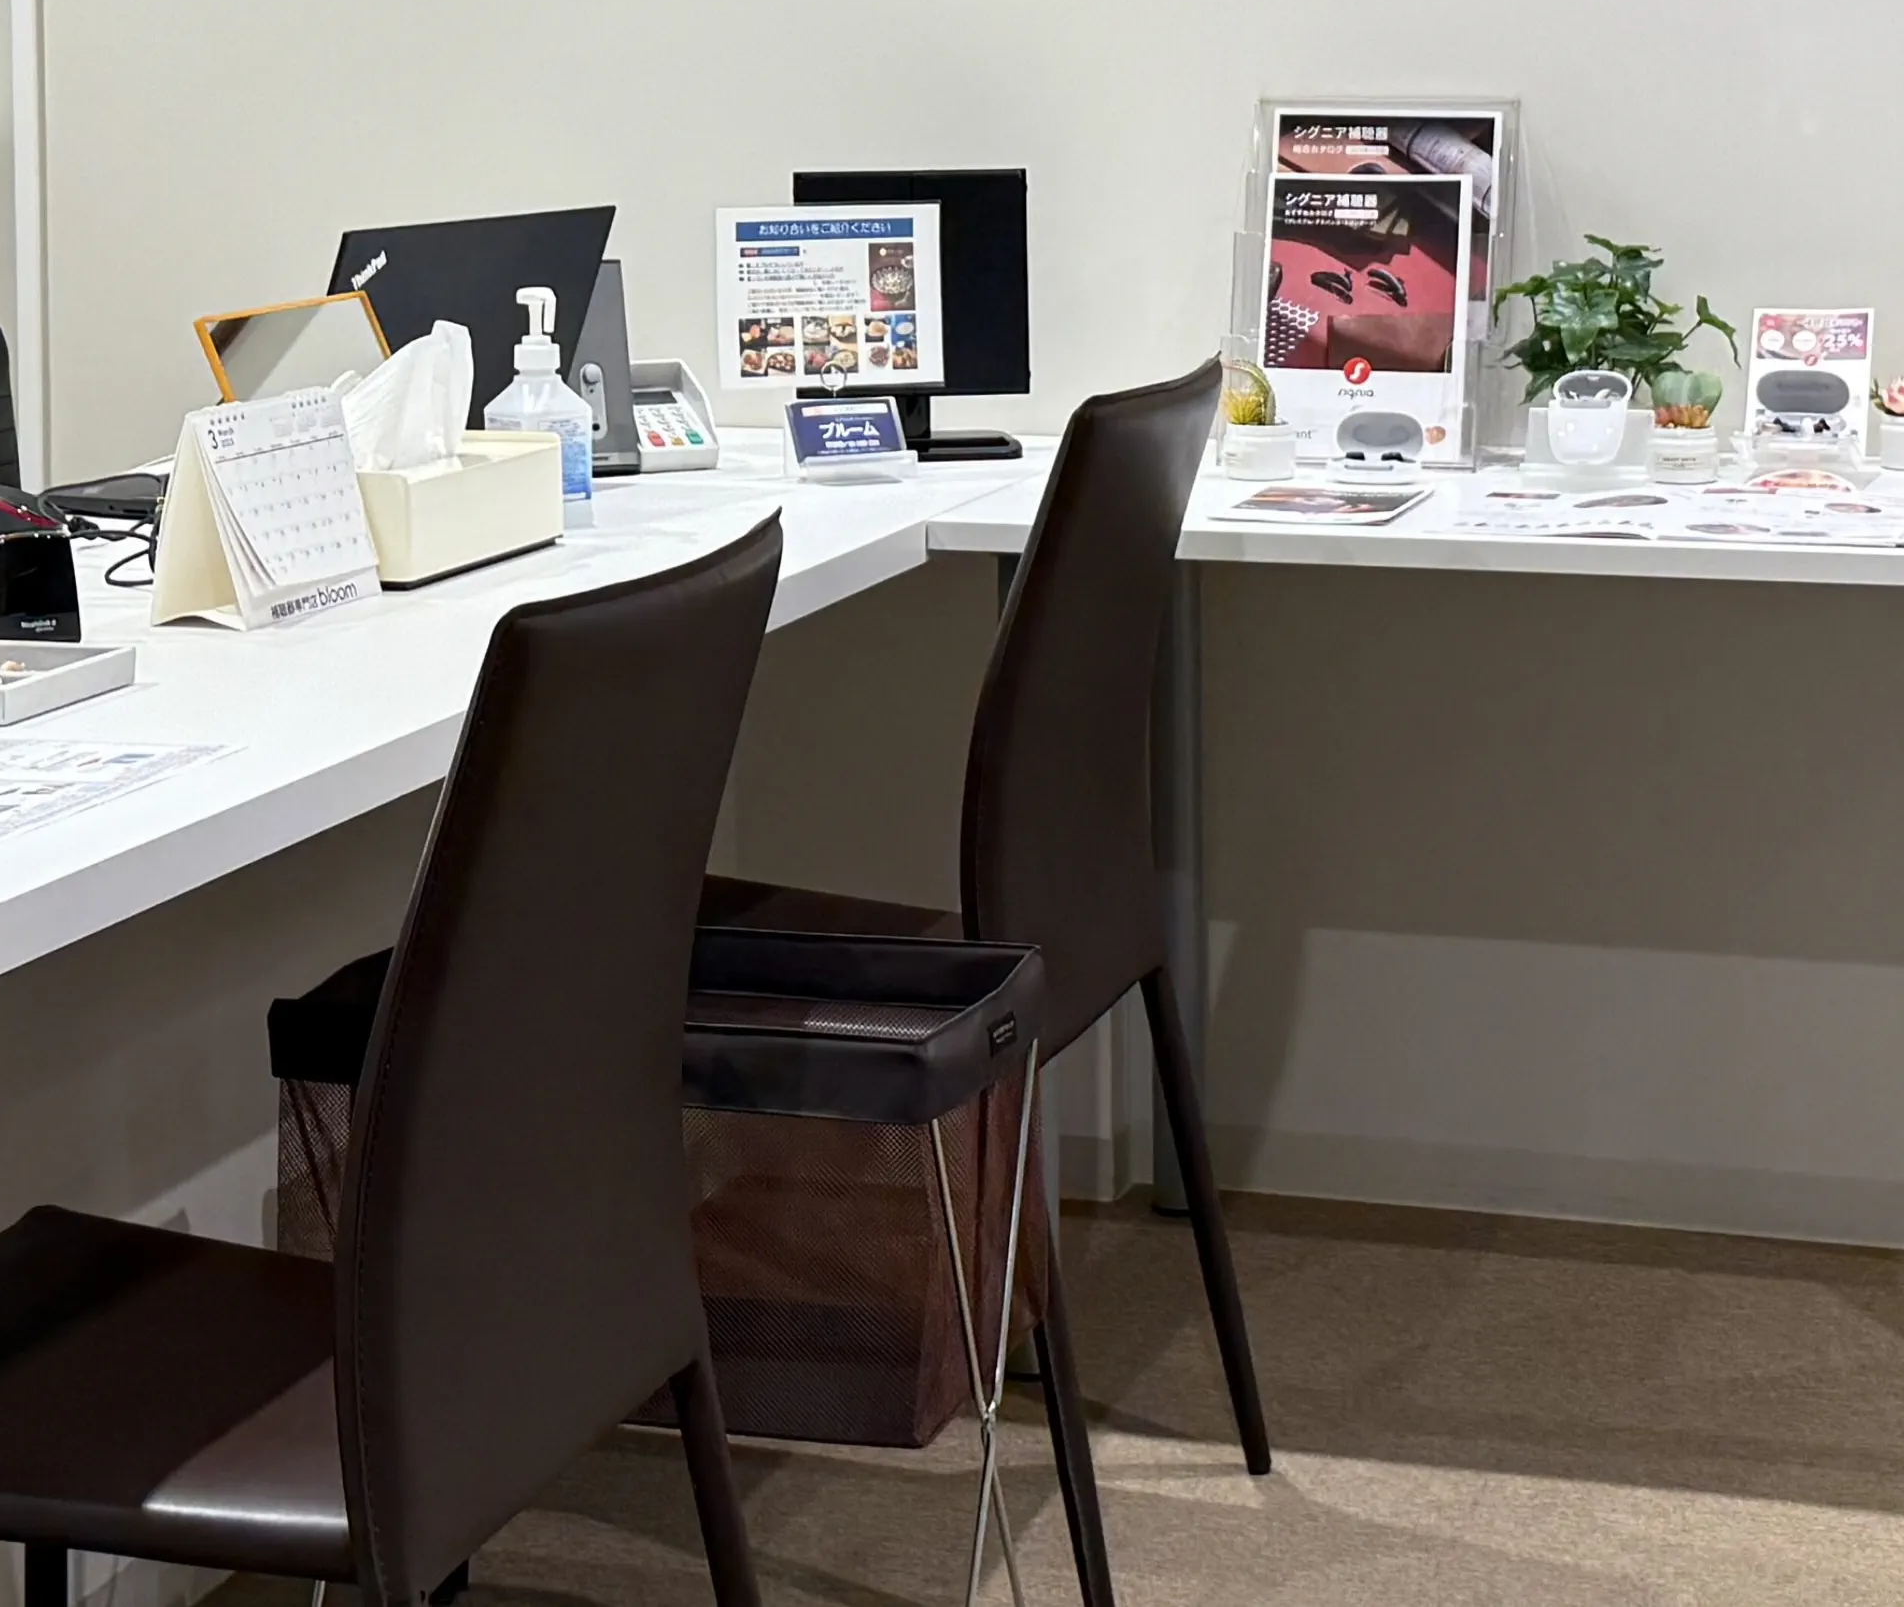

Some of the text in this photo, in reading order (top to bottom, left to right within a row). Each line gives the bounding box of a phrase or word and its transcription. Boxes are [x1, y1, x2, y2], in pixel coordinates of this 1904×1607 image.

[1293, 125, 1388, 141] シグニア補聴器
[1285, 192, 1378, 207] シグニア補聴器
[317, 582, 358, 606] bloom
